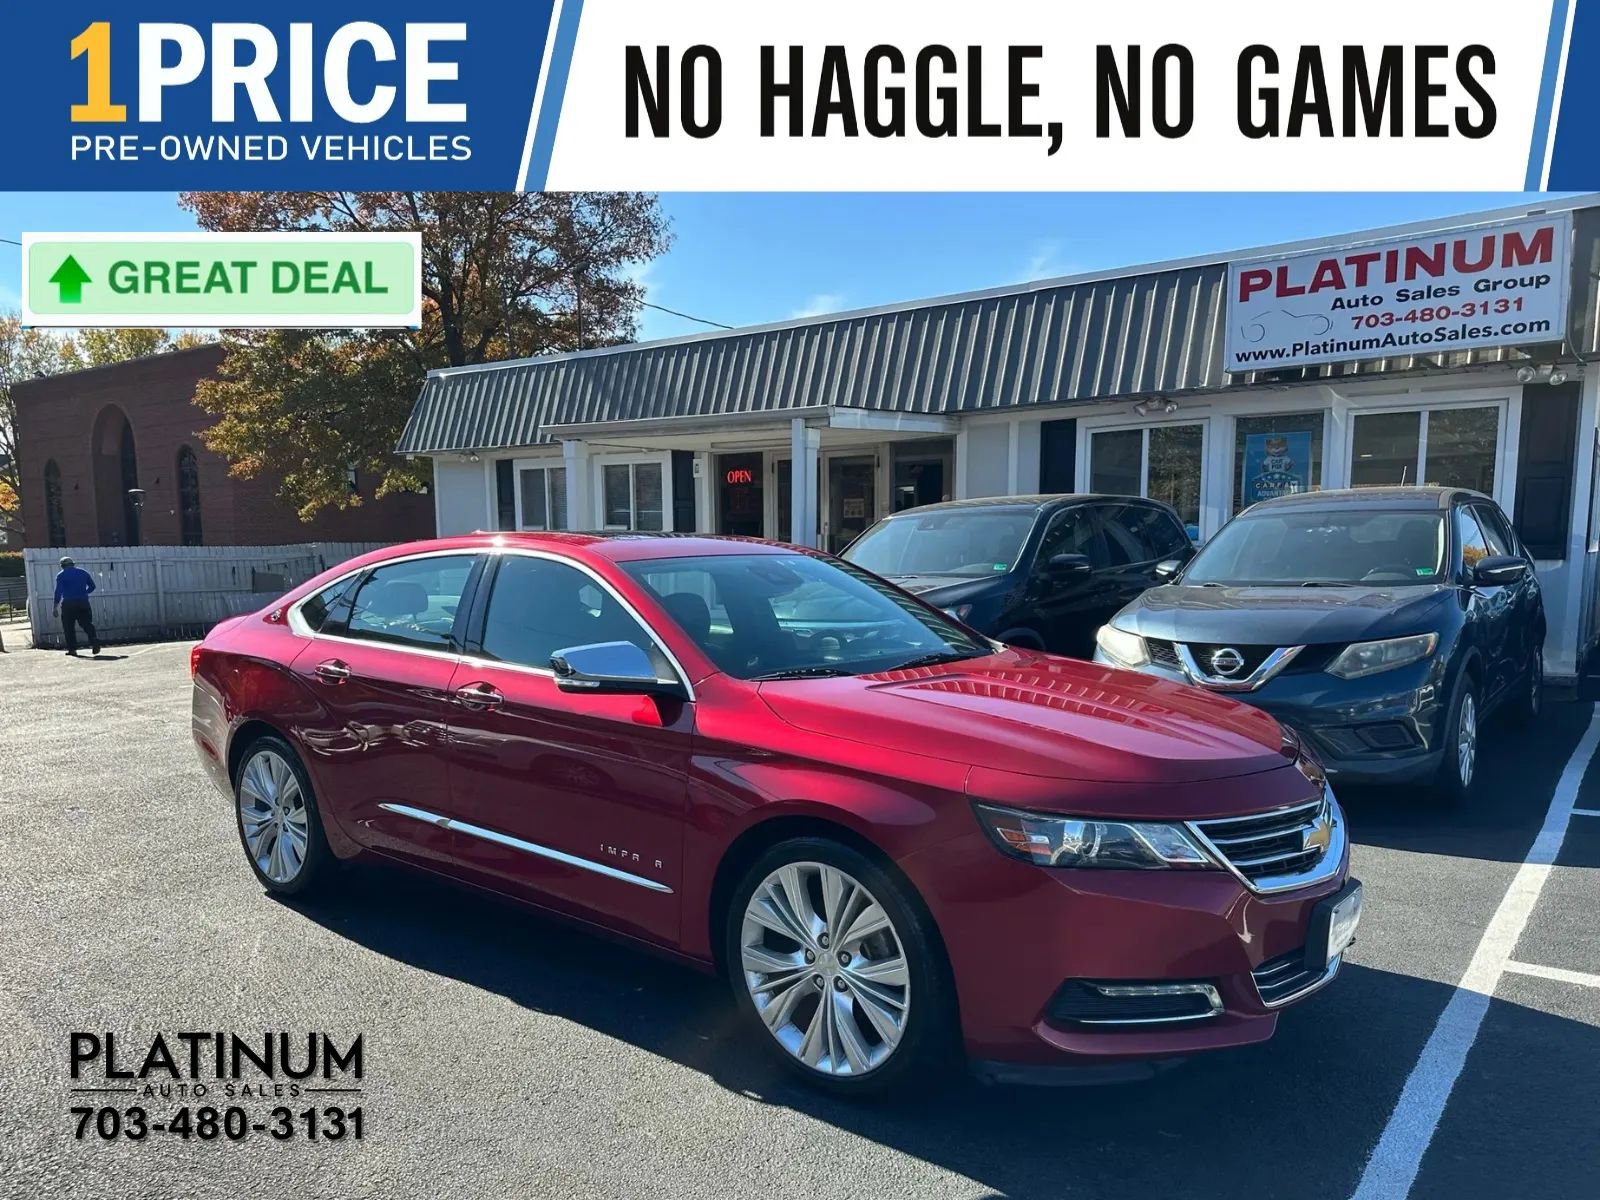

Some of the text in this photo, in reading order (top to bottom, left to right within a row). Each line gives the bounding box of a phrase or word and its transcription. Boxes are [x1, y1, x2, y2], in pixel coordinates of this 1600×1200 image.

[1239, 227, 1554, 303] PLATINUM
[1331, 274, 1551, 311] Auto Sales Group
[1351, 296, 1523, 330] 703-480-3131
[1235, 319, 1551, 363] www.PlatinumAutoSales.com
[727, 469, 752, 484] OPEN
